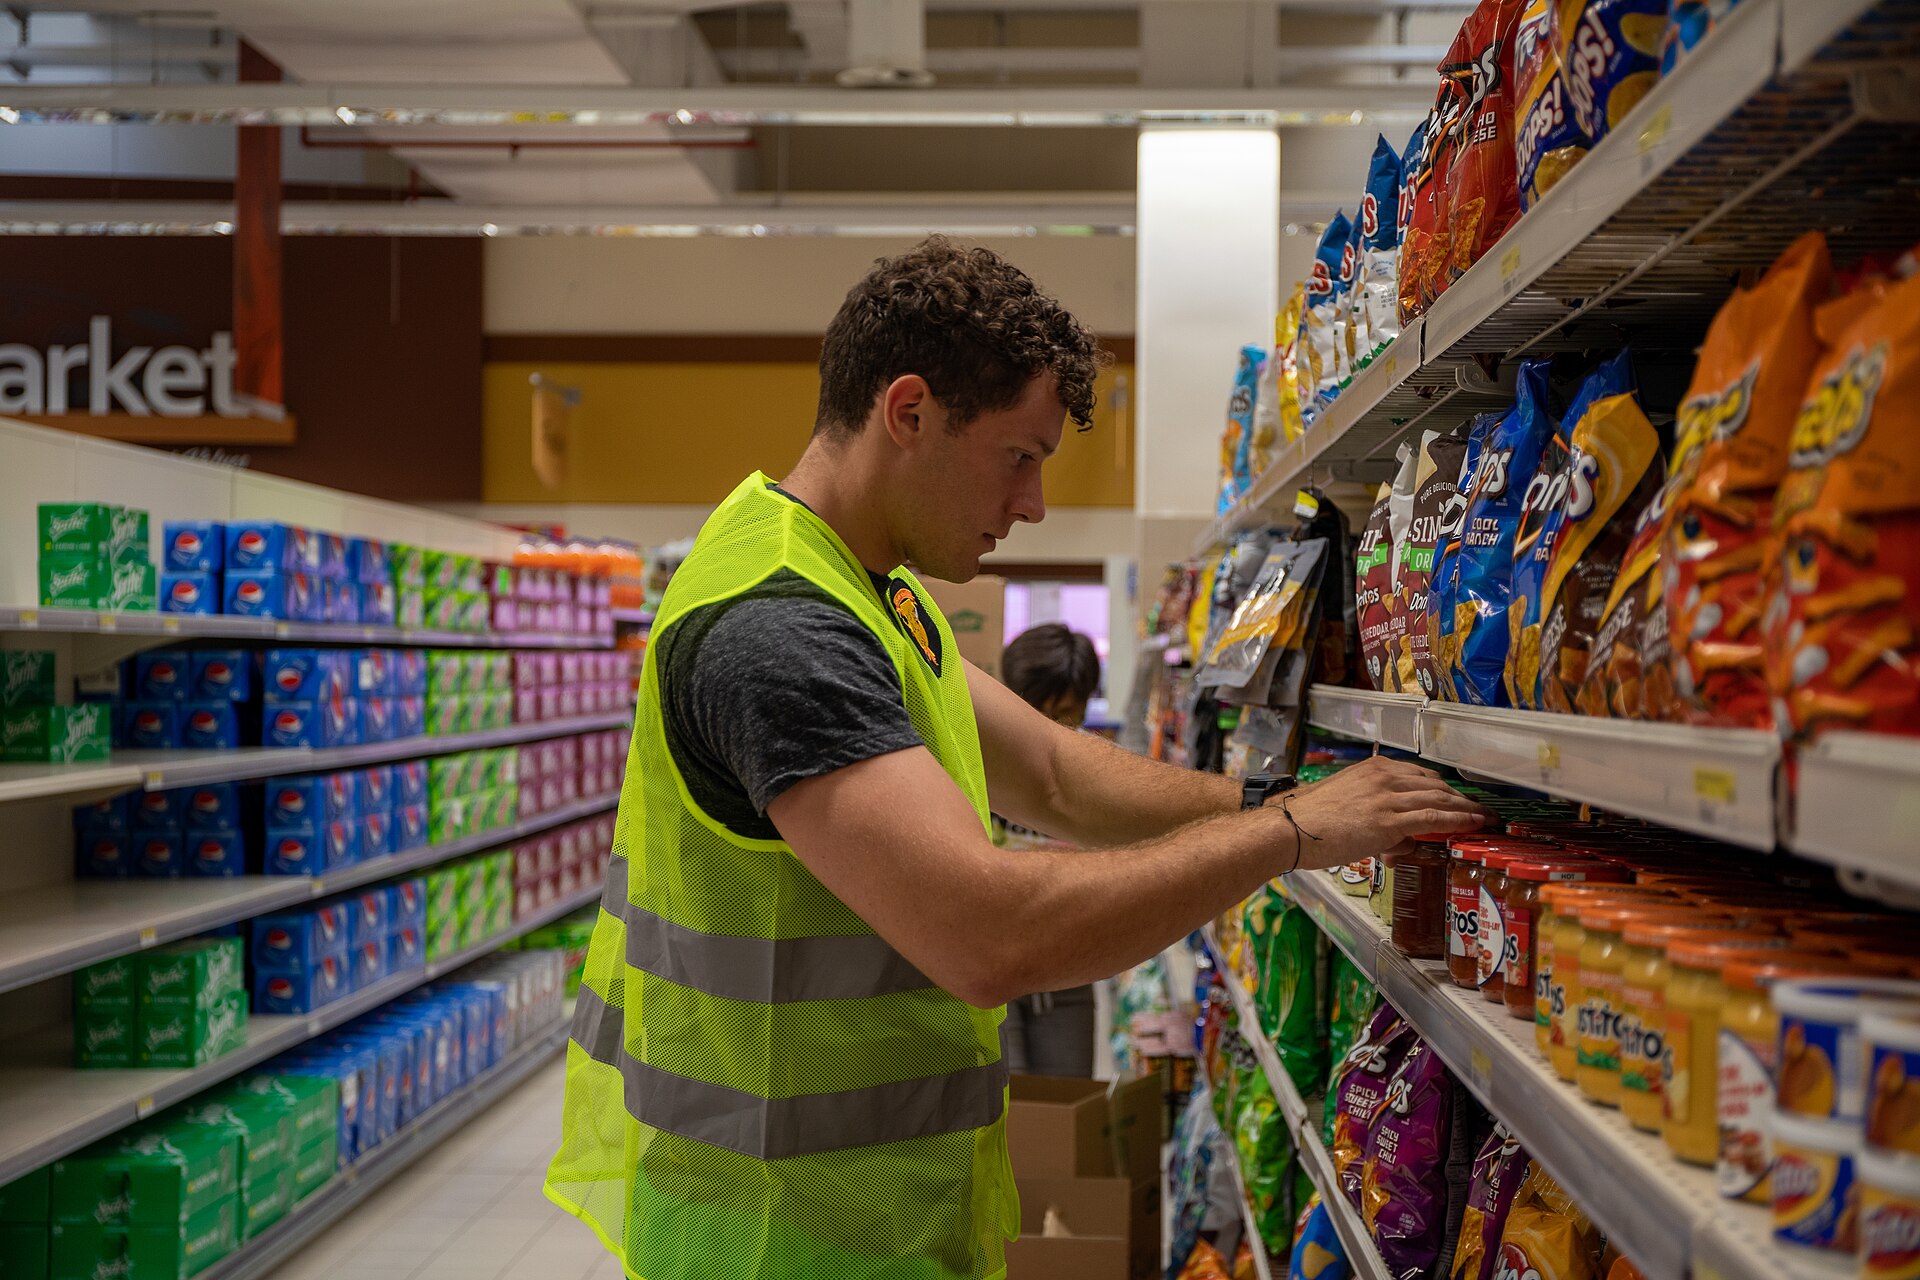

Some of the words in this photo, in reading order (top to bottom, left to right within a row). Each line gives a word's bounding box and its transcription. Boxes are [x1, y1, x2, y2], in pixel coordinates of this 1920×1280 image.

[1472, 518, 1499, 531] COOL
[1465, 532, 1499, 546] RANCH
[1350, 1083, 1378, 1100] SPICY
[1344, 1092, 1376, 1110] SWEET
[1348, 1104, 1372, 1120] CHILI
[1381, 1125, 1400, 1141] SPICY
[1376, 1136, 1398, 1151] SWEET
[1378, 1148, 1397, 1165] CHILI
